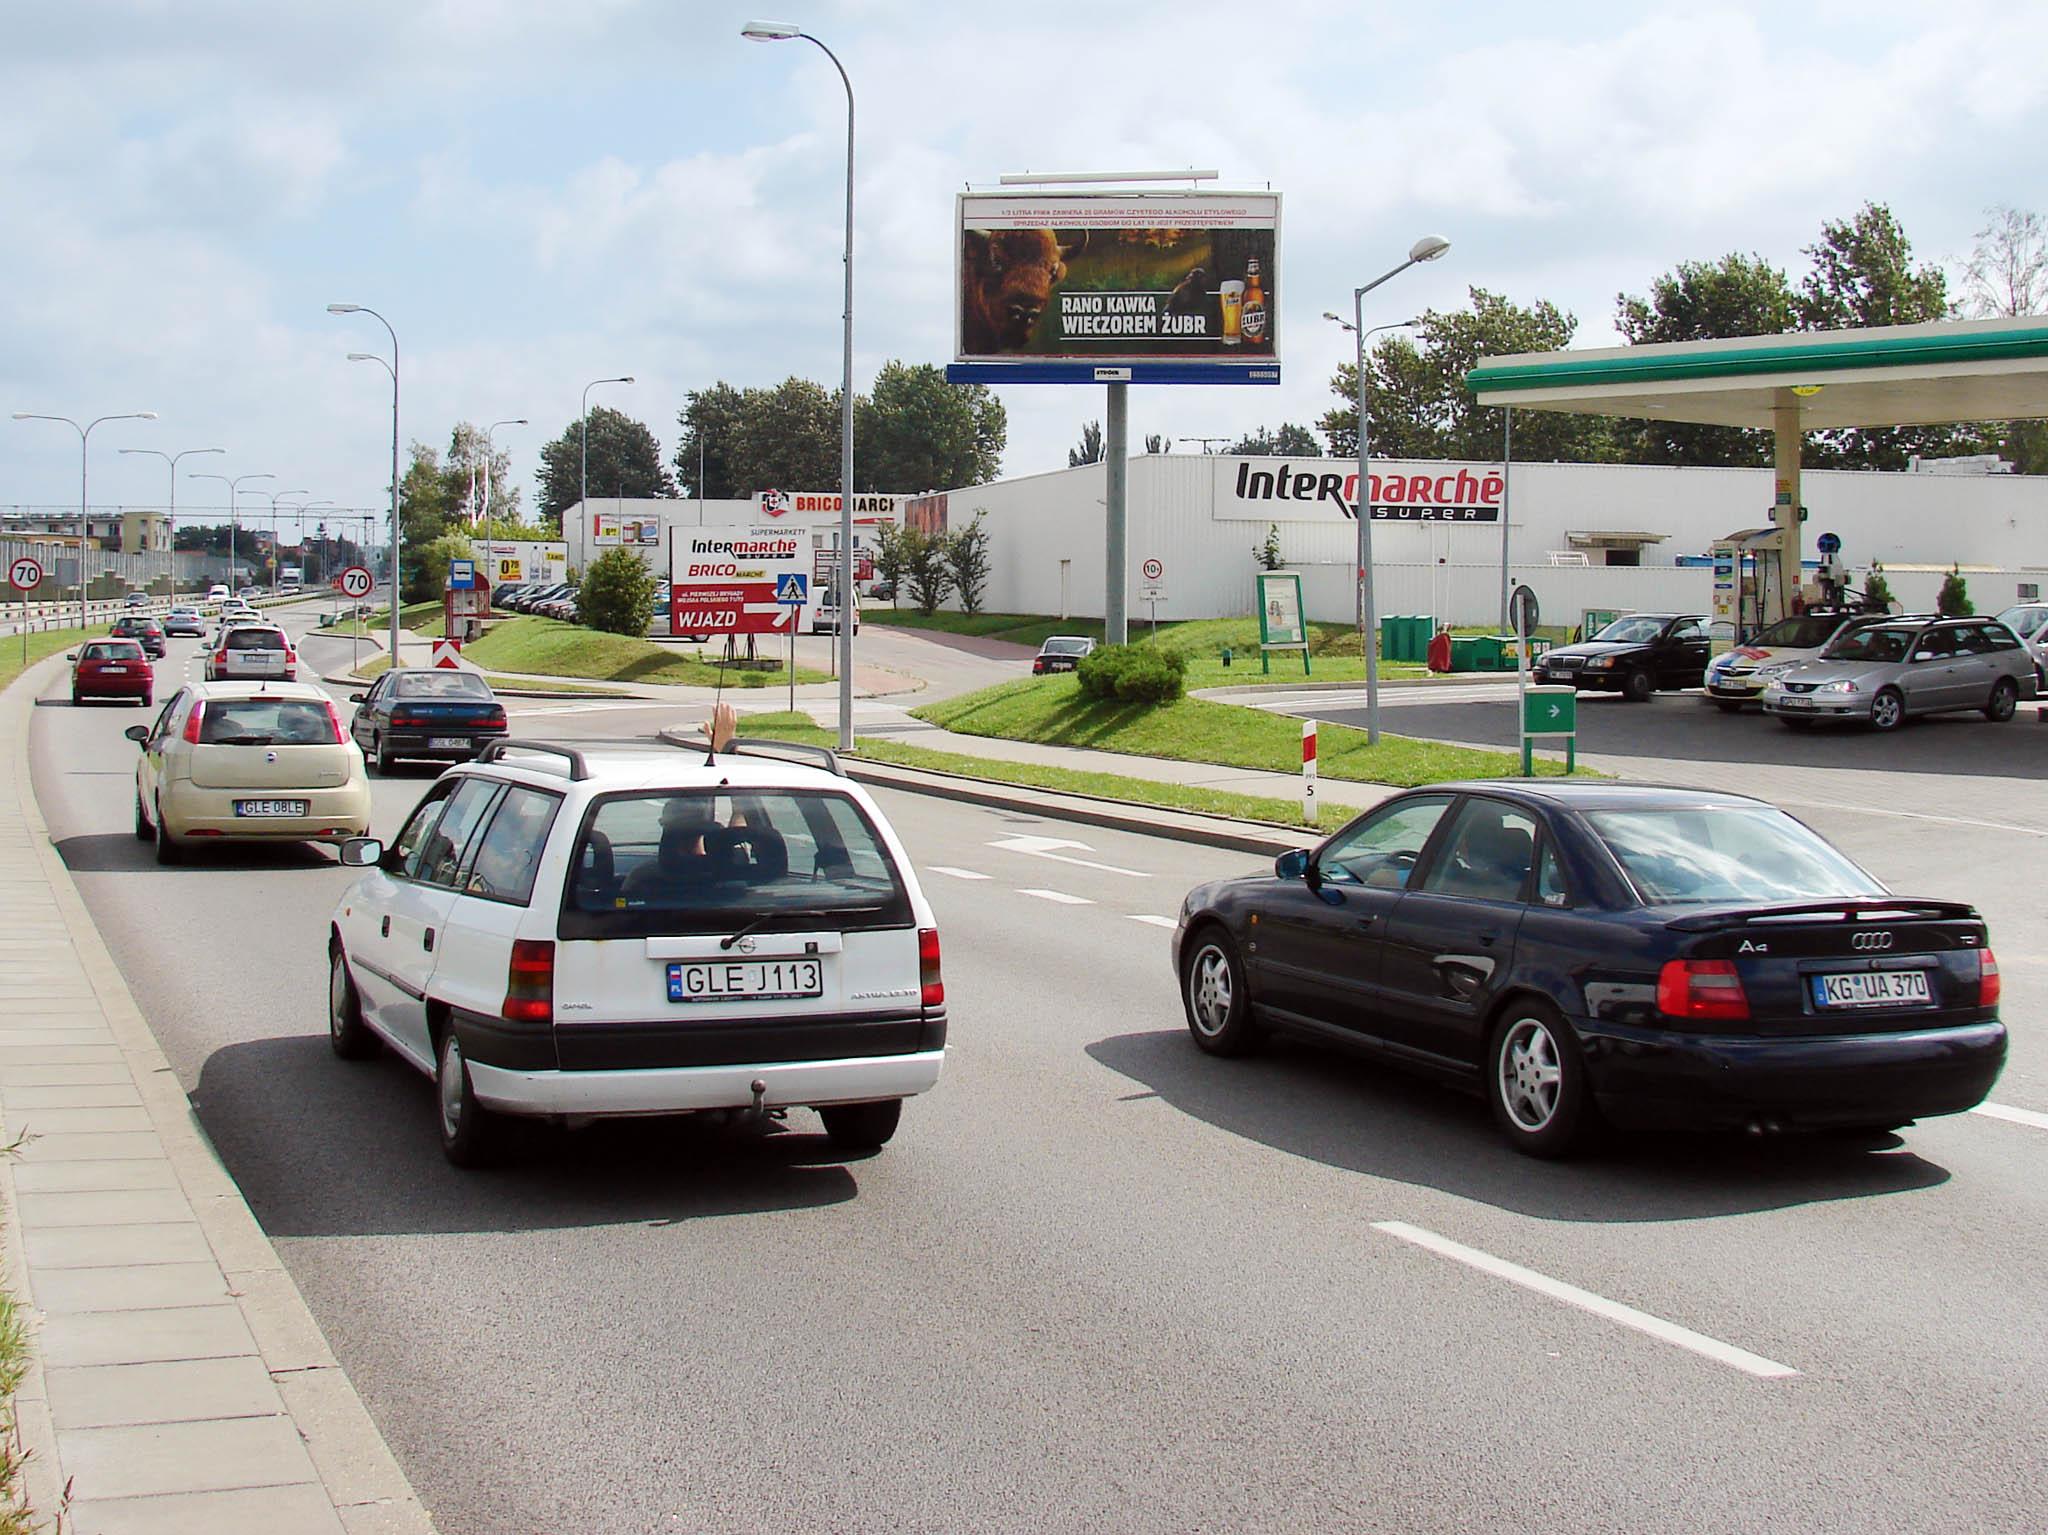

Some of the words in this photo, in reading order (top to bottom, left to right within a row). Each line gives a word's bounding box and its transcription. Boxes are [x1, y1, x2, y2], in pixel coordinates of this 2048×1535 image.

[1062, 296, 1102, 313] RANO
[1106, 296, 1156, 313] KAWKA
[1062, 315, 1157, 334] WIECZOREM
[1161, 312, 1206, 334] ŻUBR
[750, 528, 806, 536] SUPERMARKETY
[692, 538, 797, 560] Intermarché
[17, 566, 38, 582] 70
[688, 564, 737, 577] BRICO
[347, 574, 368, 590] 70
[678, 610, 737, 628] WJAZD
[1306, 785, 1314, 796] 5
[245, 801, 270, 813] GLE
[273, 801, 303, 813] 08LE
[686, 966, 745, 993] GLE
[757, 964, 817, 991] J113
[1825, 977, 1854, 1000] KG
[1863, 975, 1891, 998] UA
[1891, 973, 1926, 997] 370
